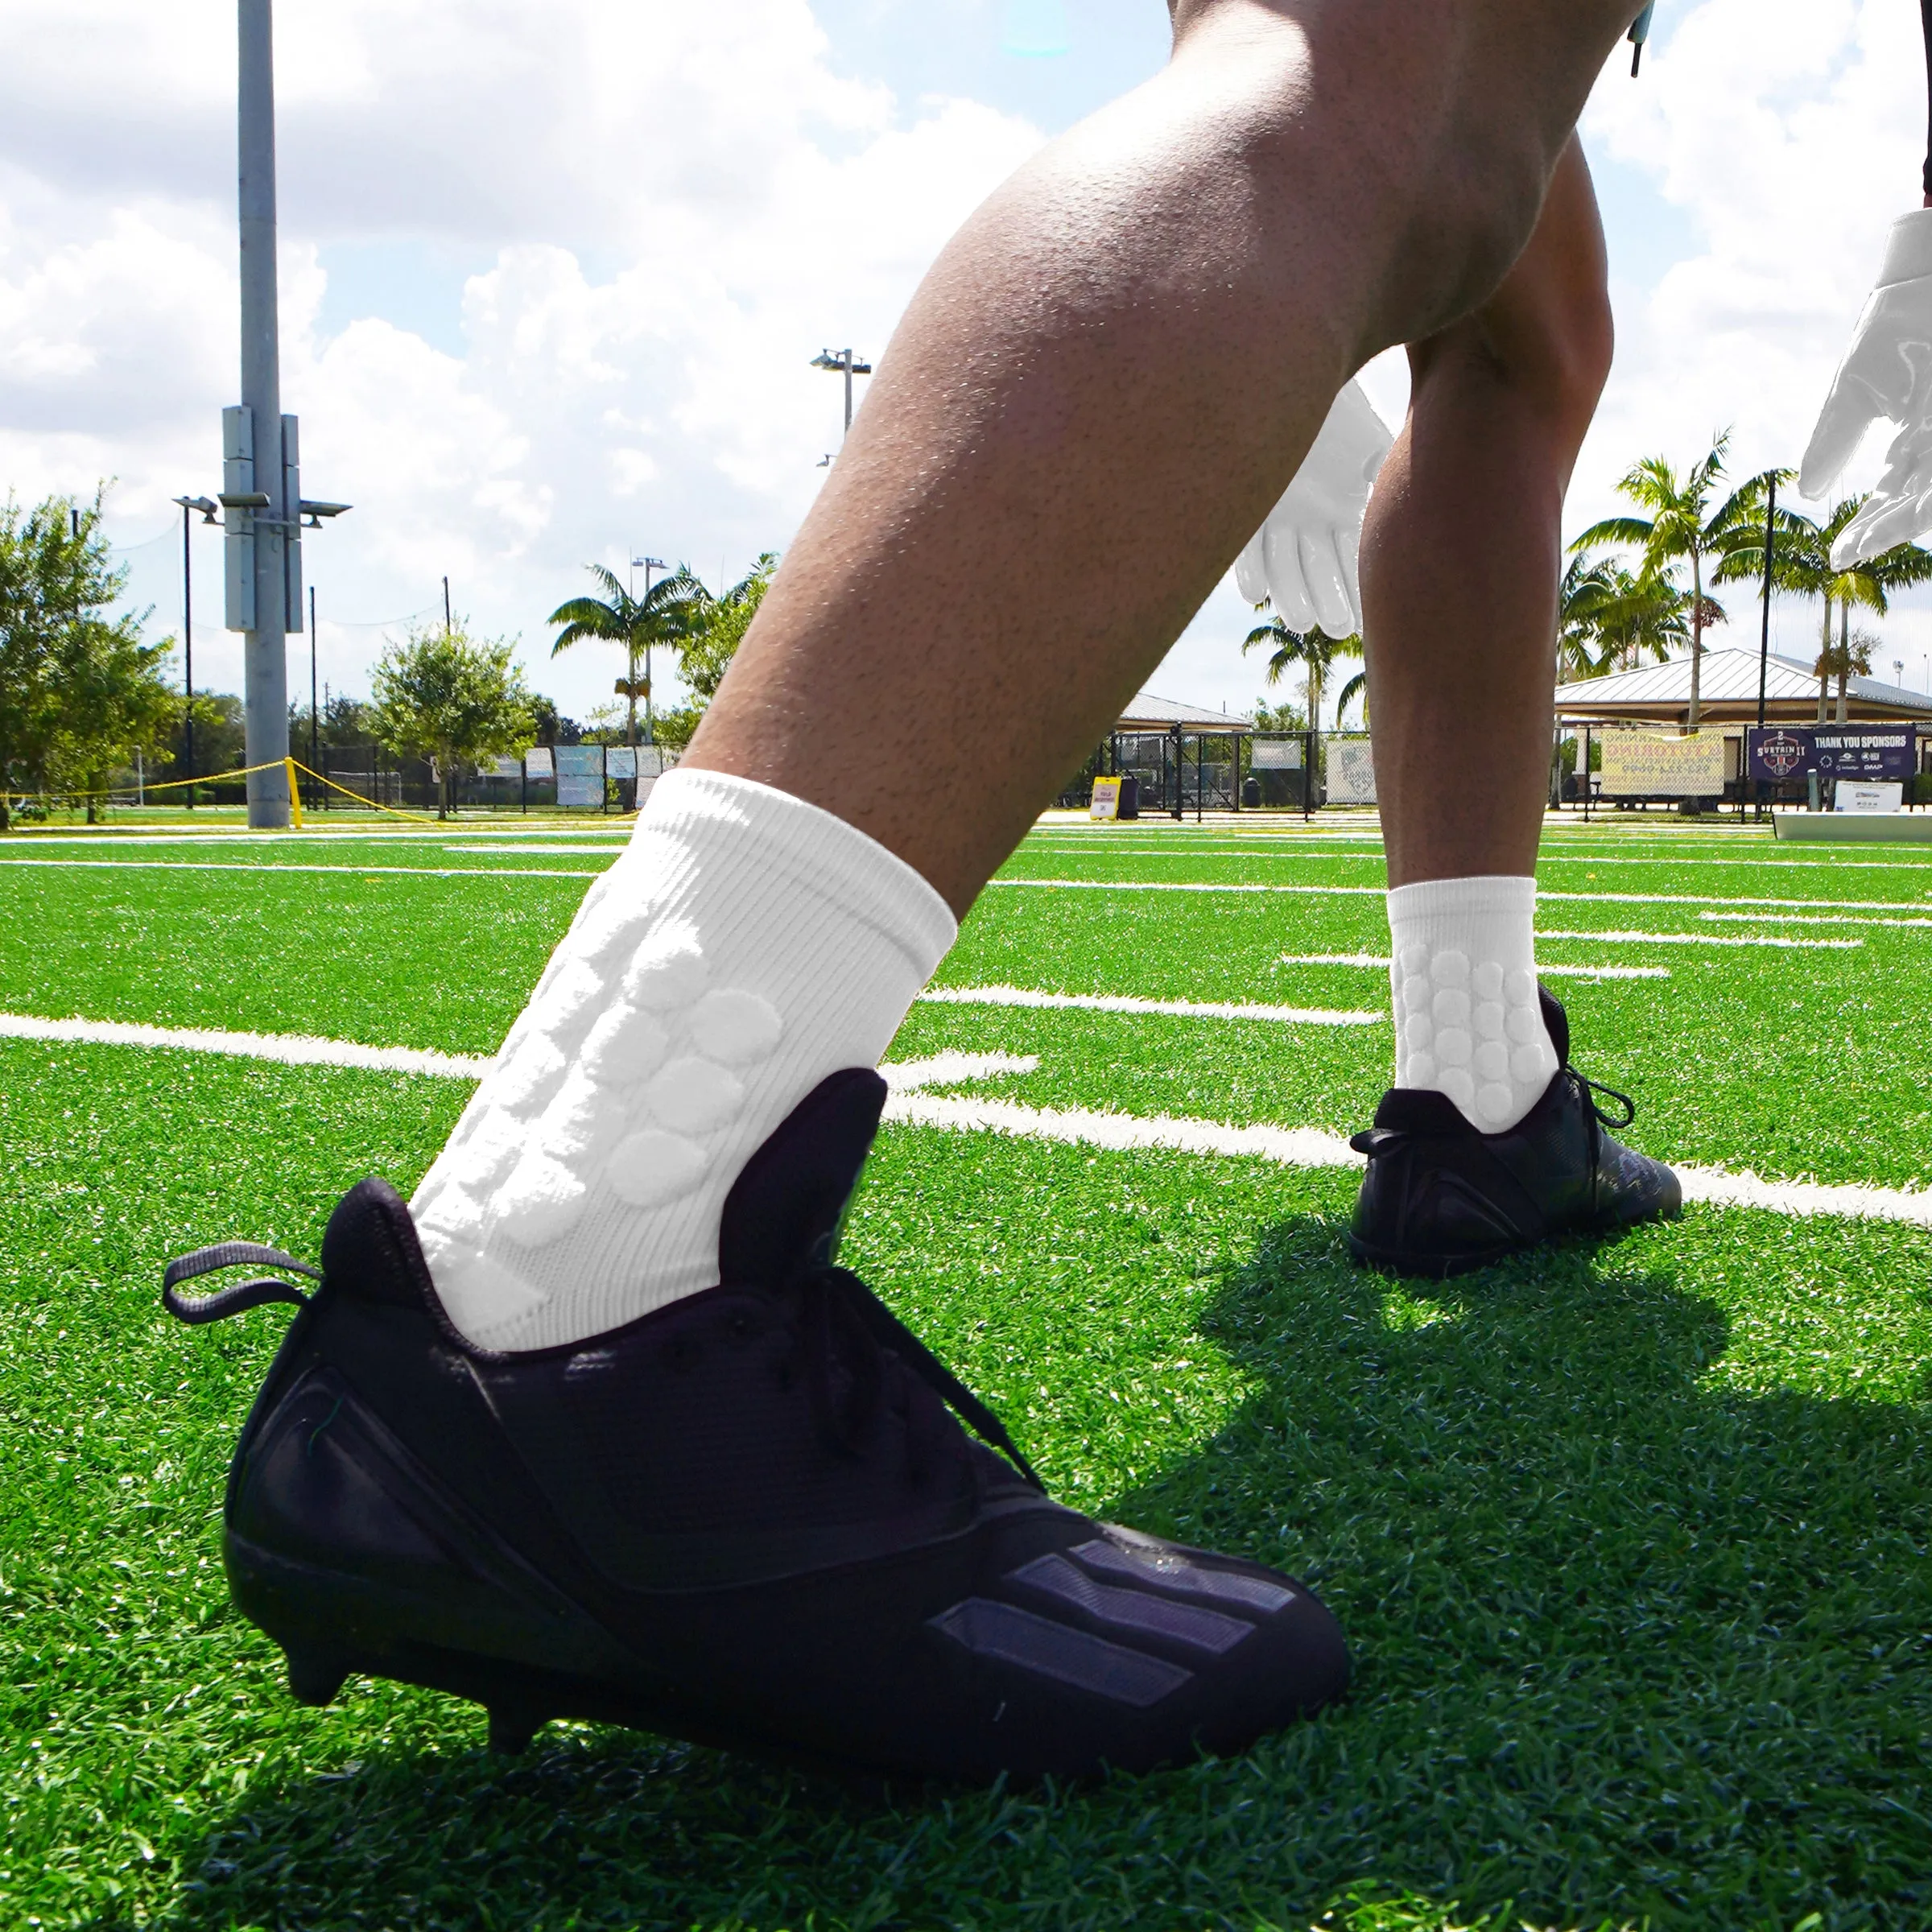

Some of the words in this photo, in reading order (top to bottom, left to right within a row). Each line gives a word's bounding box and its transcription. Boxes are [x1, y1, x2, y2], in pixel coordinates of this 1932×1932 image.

[1777, 731, 1784, 741] 2
[1814, 737, 1842, 749] THANK
[1843, 736, 1860, 749] YOU
[1861, 735, 1907, 748] SPONSORS
